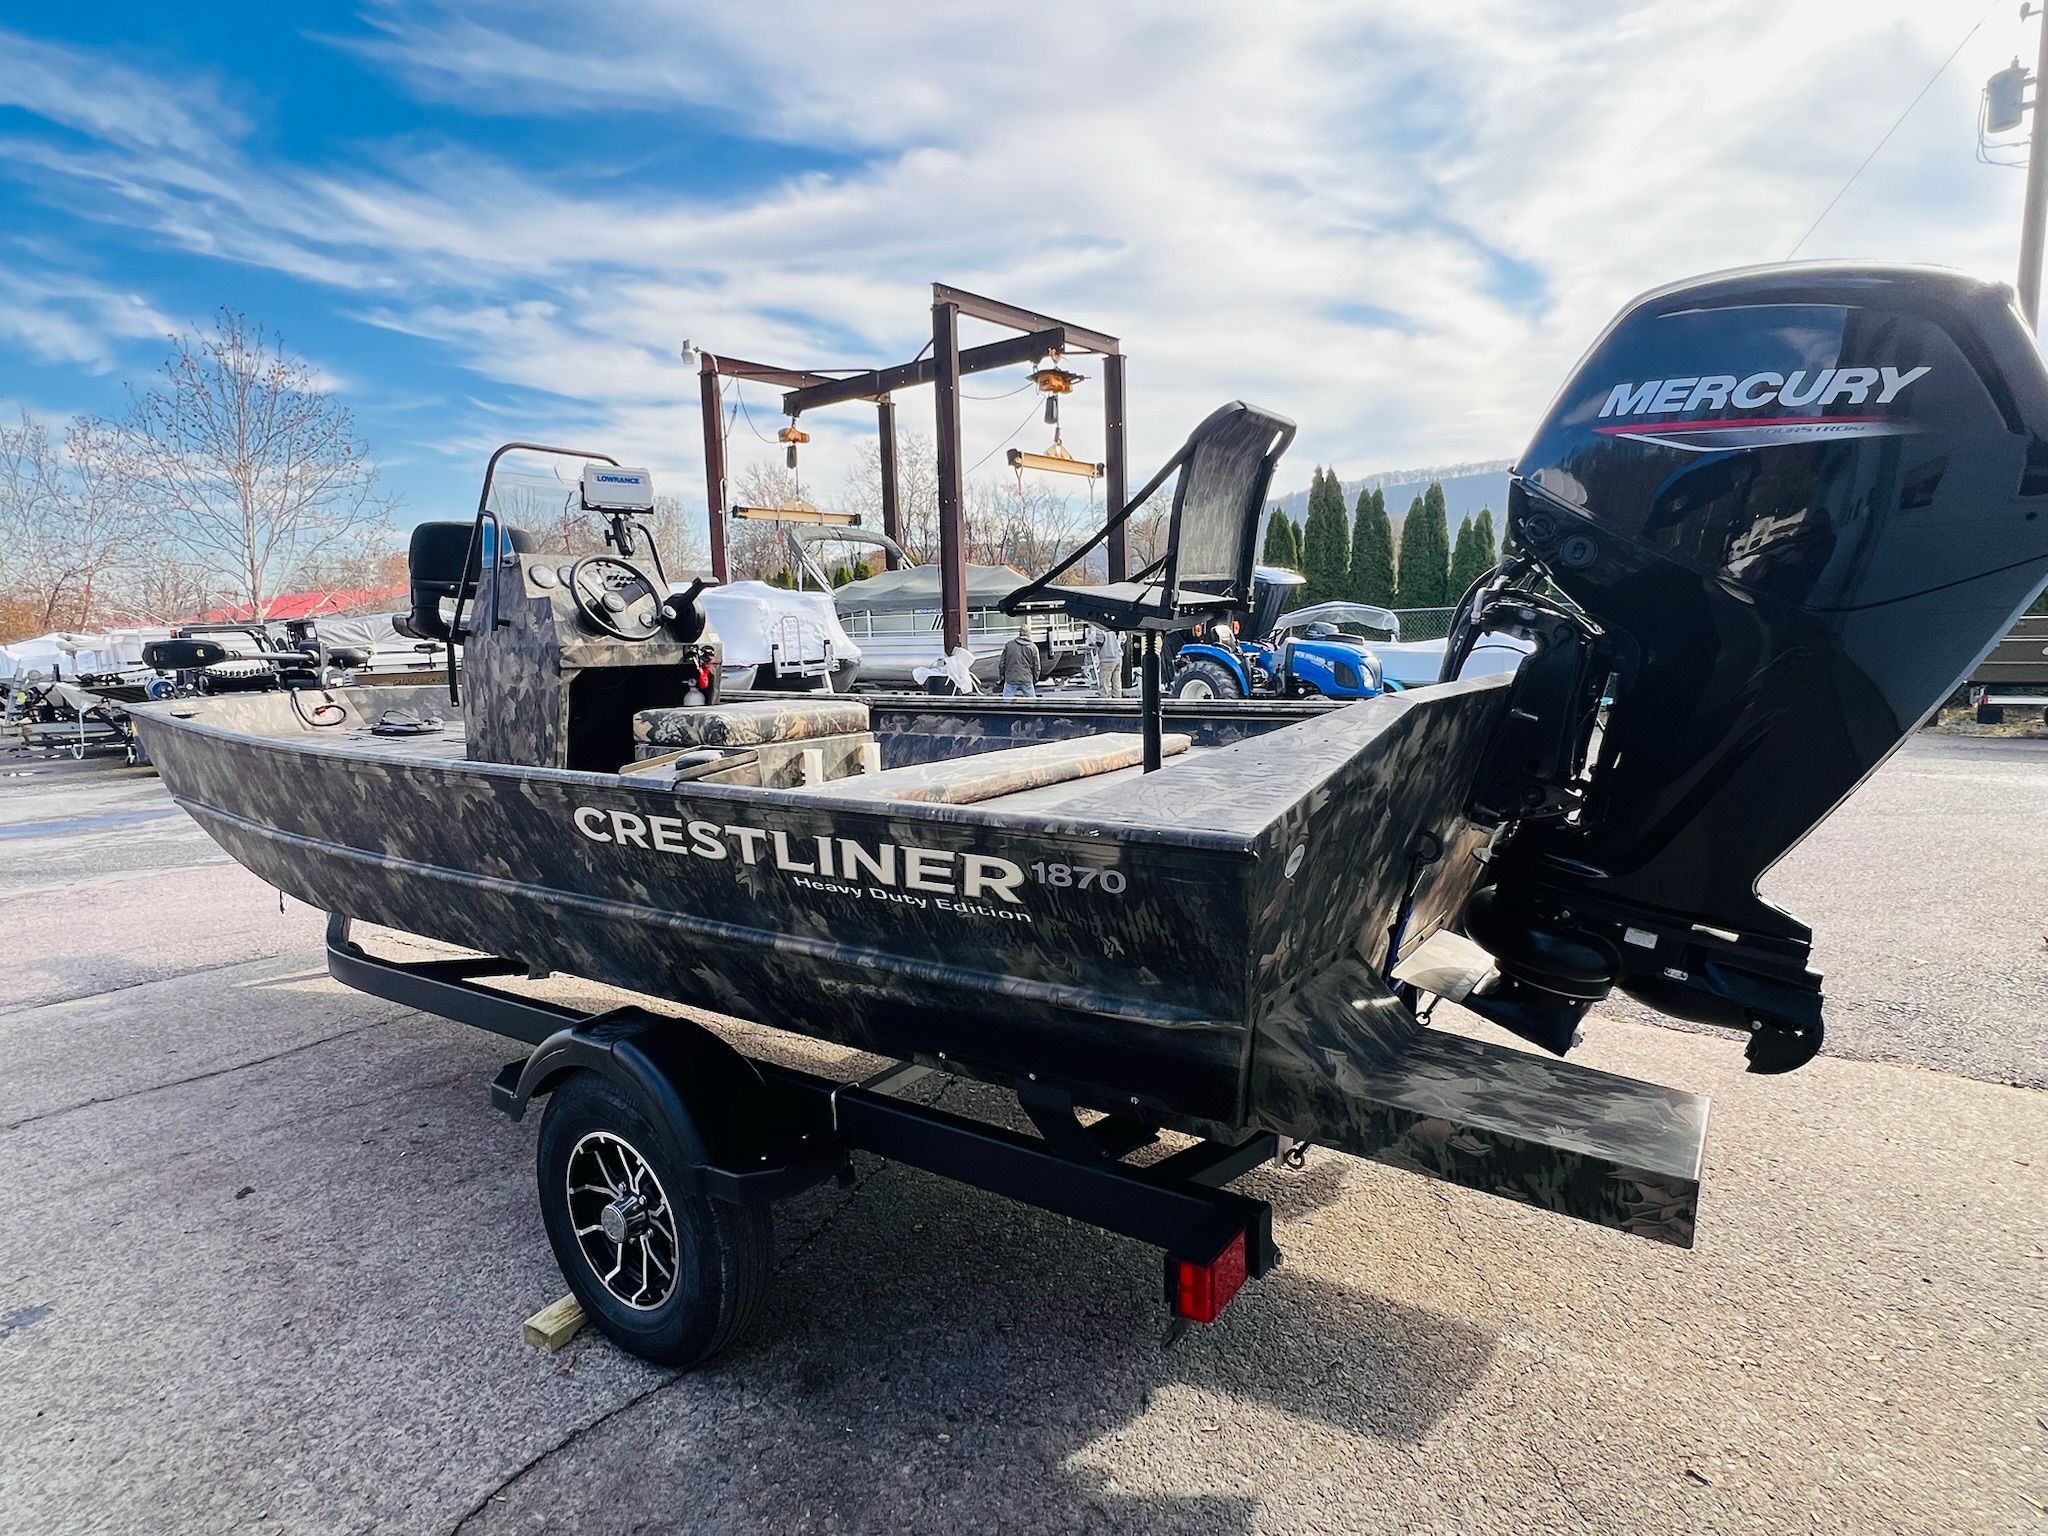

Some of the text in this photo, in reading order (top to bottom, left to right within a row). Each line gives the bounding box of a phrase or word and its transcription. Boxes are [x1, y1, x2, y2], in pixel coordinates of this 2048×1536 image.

[1598, 367, 1932, 419] MERCURY
[596, 475, 641, 485] LOWRANCE
[573, 806, 1126, 904] CRESTLINER 1870
[793, 876, 1032, 923] Heavy Duty Edition
